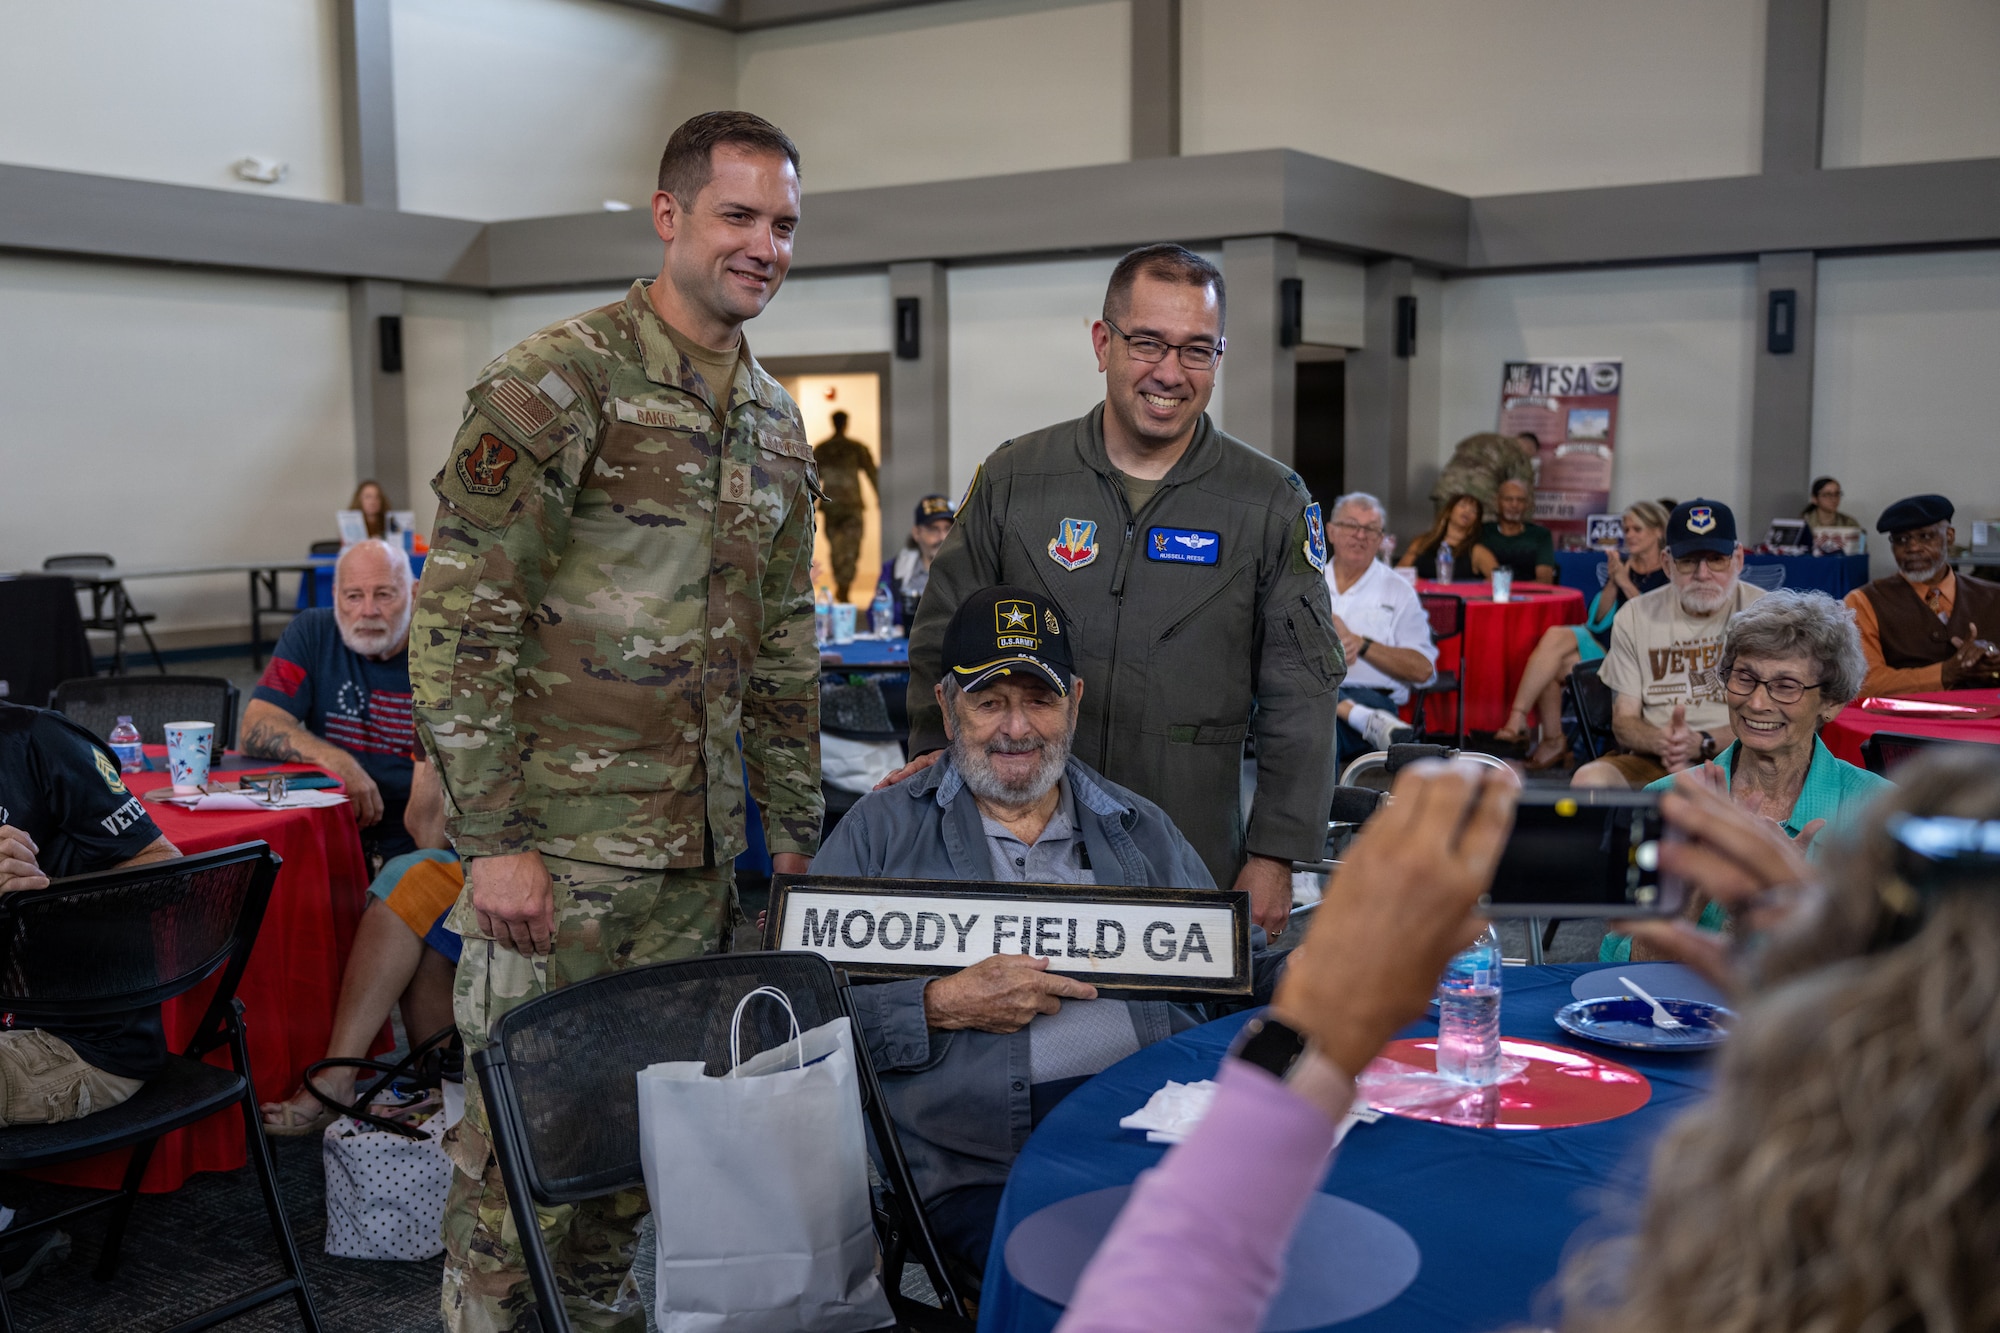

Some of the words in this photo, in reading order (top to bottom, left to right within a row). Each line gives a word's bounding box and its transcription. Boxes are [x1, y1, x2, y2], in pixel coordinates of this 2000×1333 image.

[1530, 365, 1588, 394] AFSA
[636, 409, 677, 427] BAKER
[800, 907, 979, 953] MOODY
[992, 914, 1126, 959] FIELD
[1142, 920, 1213, 963] GA
